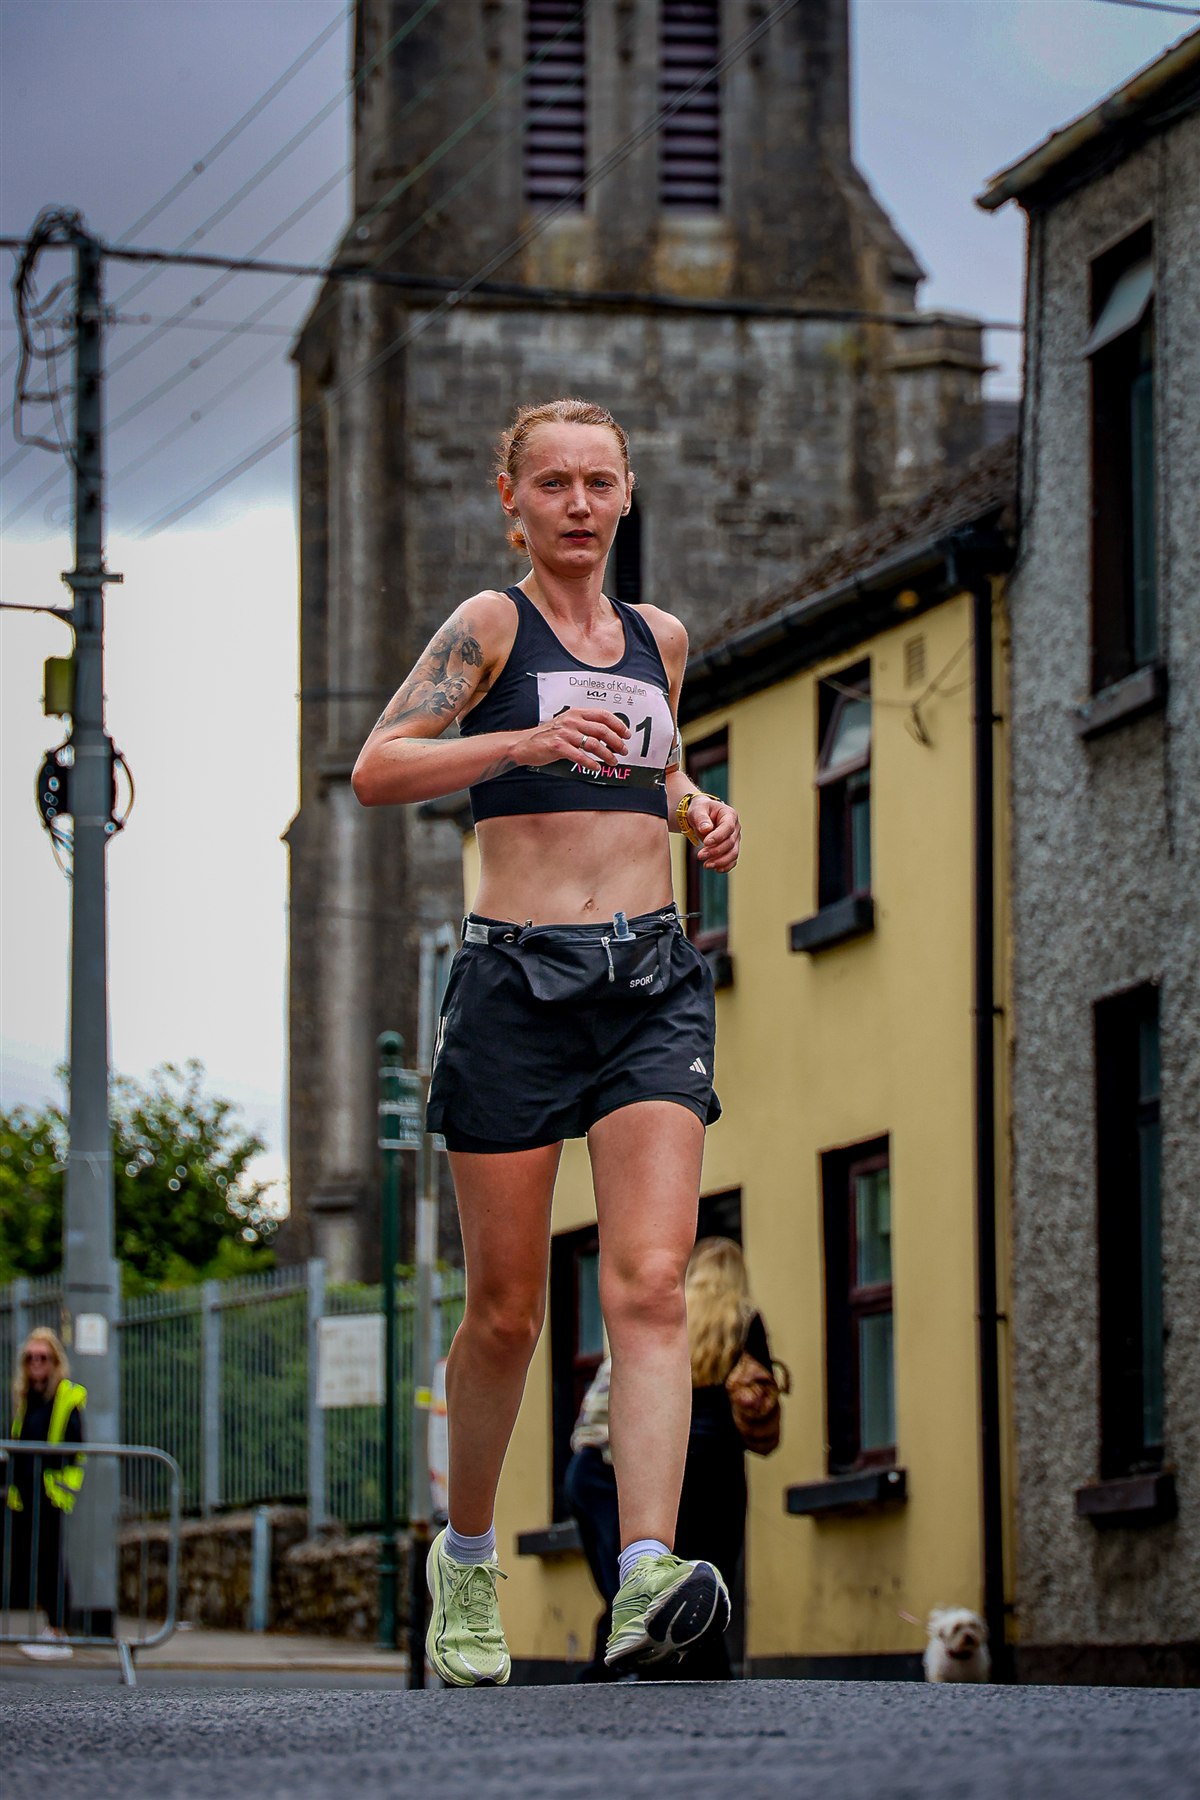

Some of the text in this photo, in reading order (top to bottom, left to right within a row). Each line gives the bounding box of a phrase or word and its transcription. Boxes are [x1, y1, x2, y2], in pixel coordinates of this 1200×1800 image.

[569, 676, 647, 696] Dunleas of Kilcullen
[587, 690, 607, 698] KIA
[629, 973, 654, 988] SPORT
